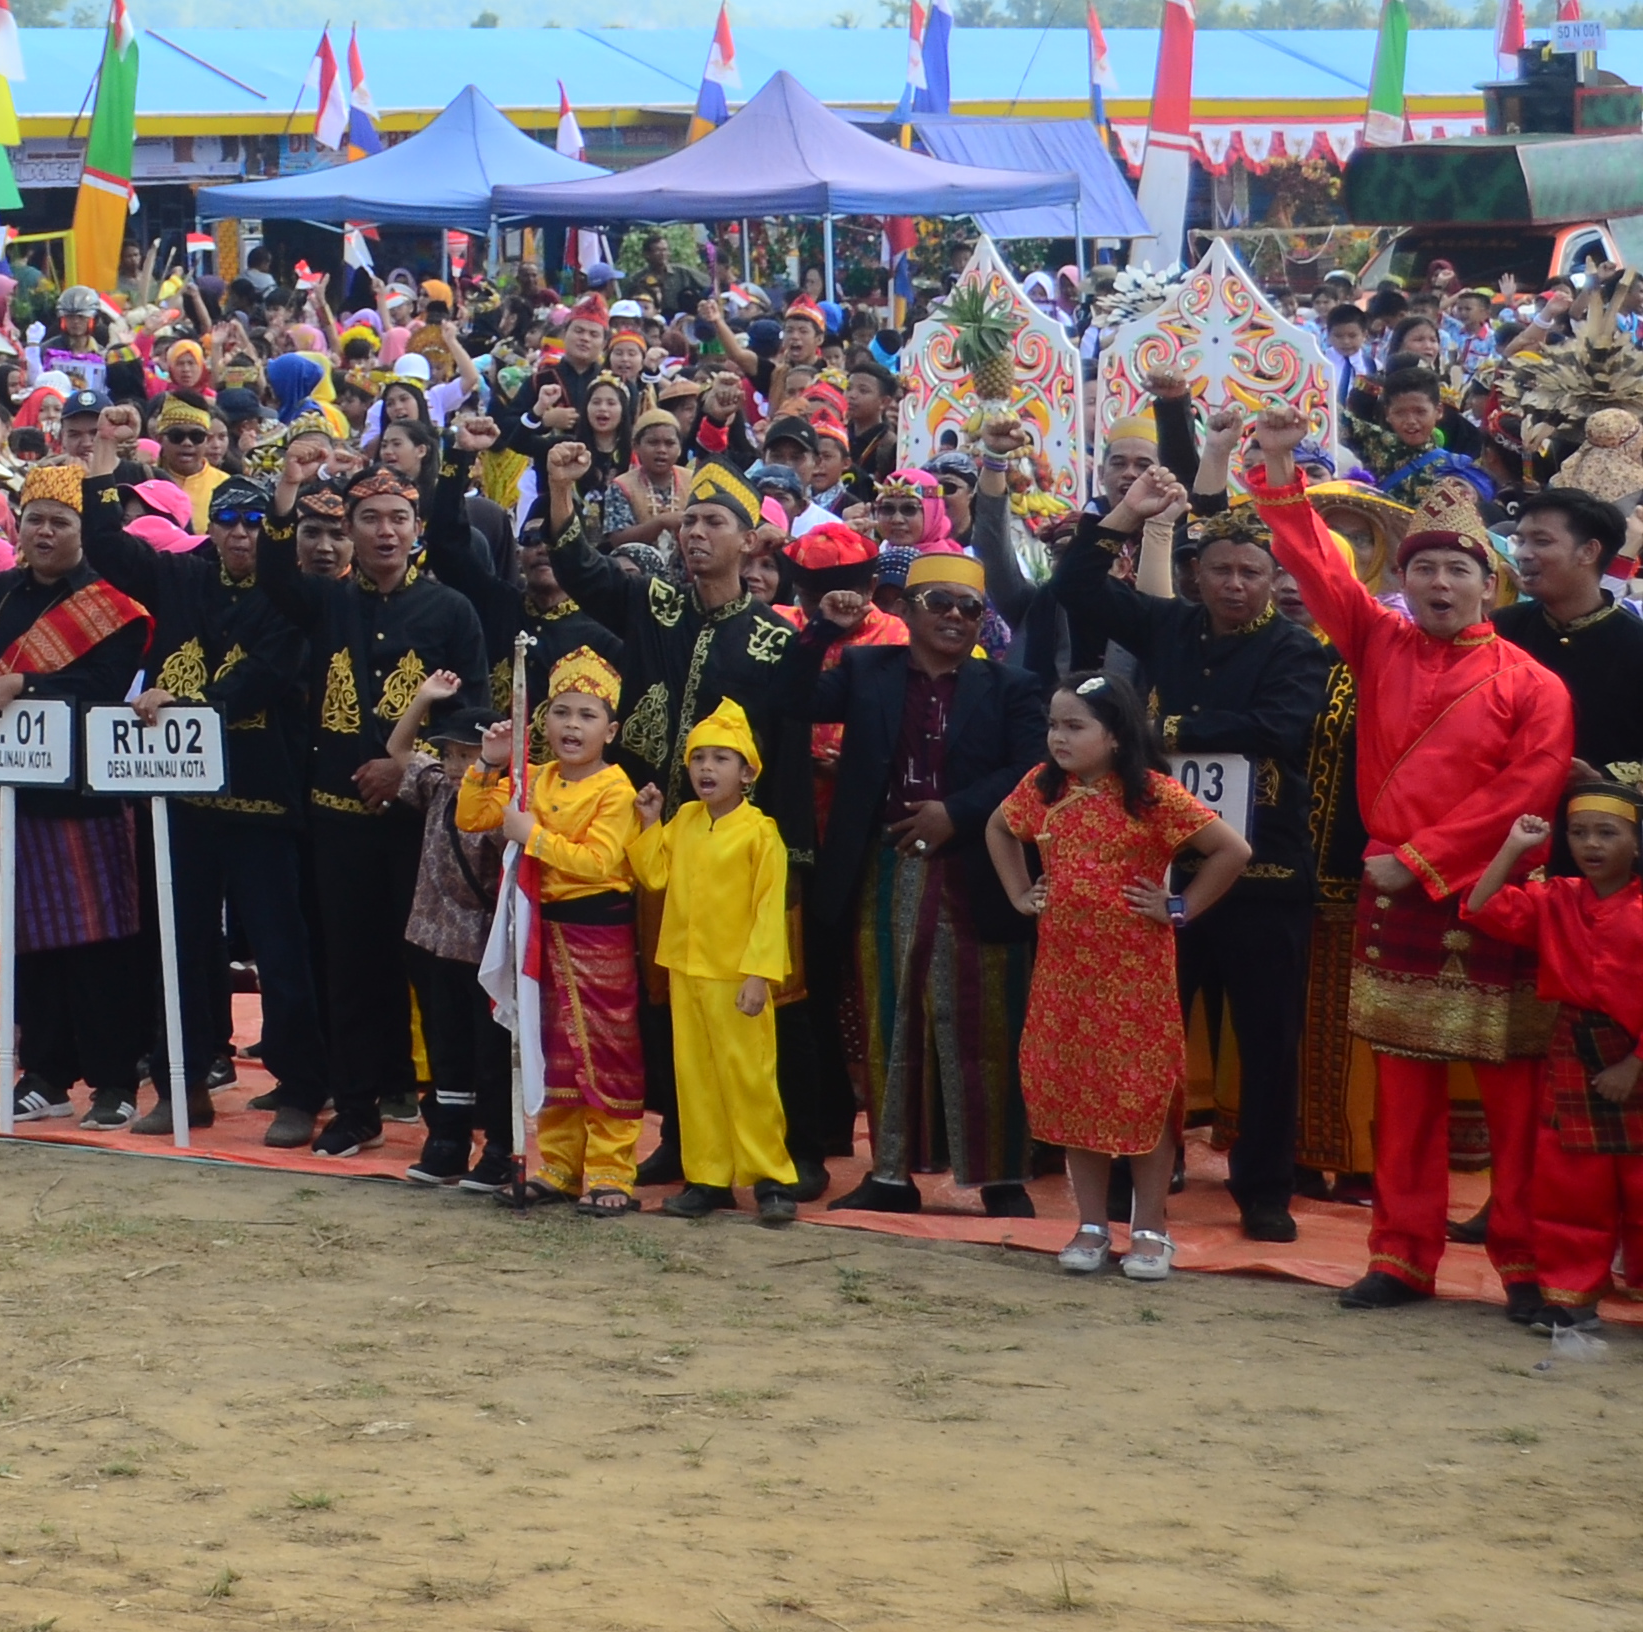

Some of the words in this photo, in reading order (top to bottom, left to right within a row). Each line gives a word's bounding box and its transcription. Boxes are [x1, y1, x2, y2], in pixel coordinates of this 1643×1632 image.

[17, 710, 46, 745] 01
[112, 719, 154, 754] RT.
[164, 718, 203, 755] 02
[28, 751, 52, 768] KOTA
[107, 760, 131, 779] DESA
[134, 760, 177, 779] MALINAU
[180, 760, 206, 779] KOTA
[1180, 760, 1224, 803] 03
